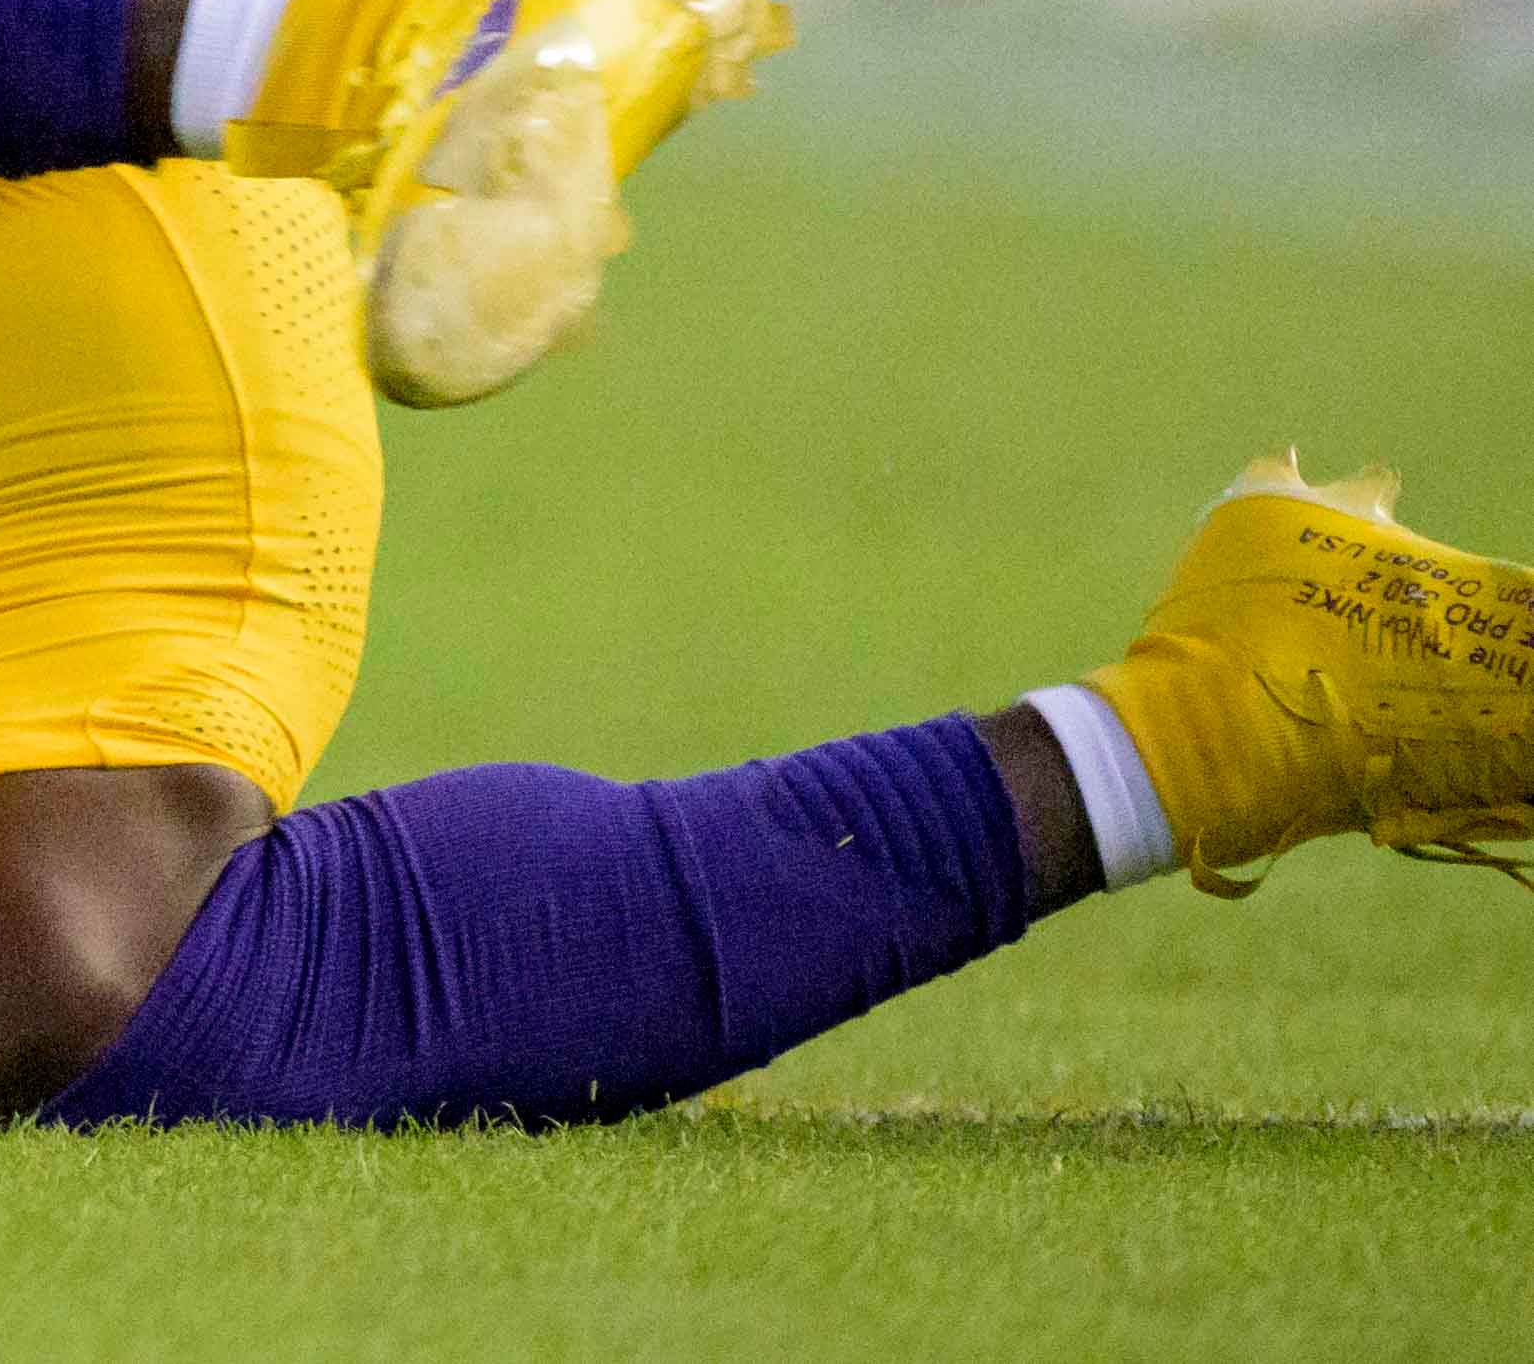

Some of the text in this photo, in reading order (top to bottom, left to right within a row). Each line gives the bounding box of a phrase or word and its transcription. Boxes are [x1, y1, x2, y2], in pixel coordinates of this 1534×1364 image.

[1299, 527, 1366, 559] USA
[1292, 581, 1376, 624] NIKE
[1445, 603, 1515, 640] PRO
